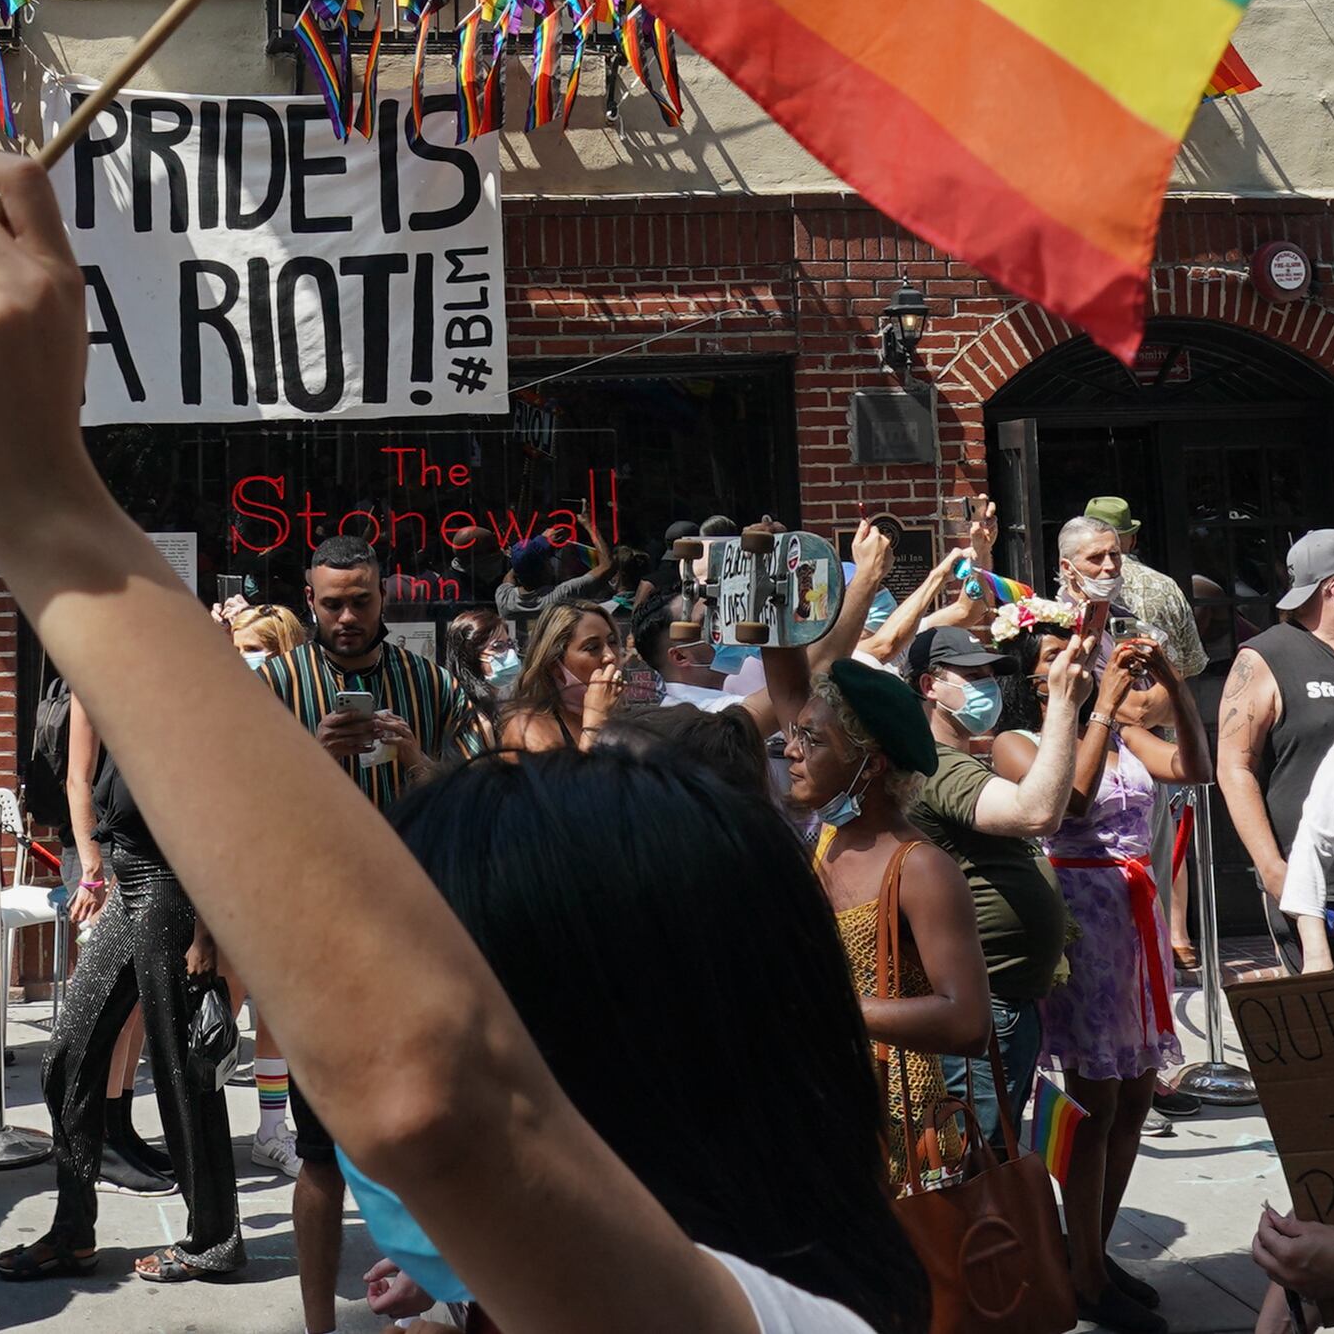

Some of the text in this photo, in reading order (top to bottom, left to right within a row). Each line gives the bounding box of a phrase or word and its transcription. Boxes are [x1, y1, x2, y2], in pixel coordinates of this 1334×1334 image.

[70, 91, 483, 234] PRIDE IS
[83, 251, 436, 413] A RIOT!
[444, 246, 494, 396] #BLM
[230, 468, 620, 553] Stonewall
[380, 446, 473, 489] The
[395, 562, 462, 603] Inn
